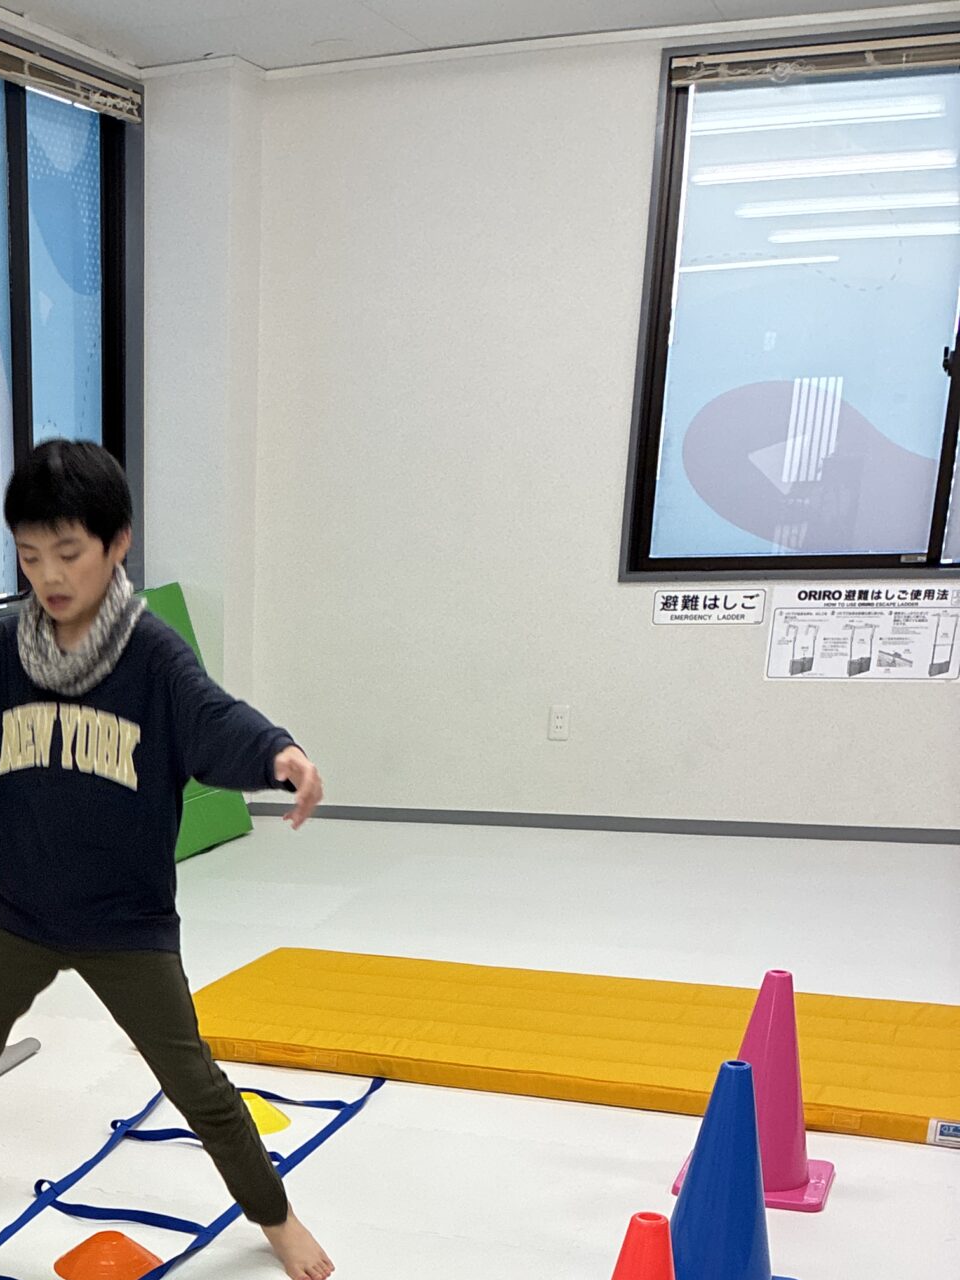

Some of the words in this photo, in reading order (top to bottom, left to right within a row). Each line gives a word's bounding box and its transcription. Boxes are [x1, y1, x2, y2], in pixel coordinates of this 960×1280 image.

[660, 594, 760, 611] 避難はしご
[797, 590, 842, 601] ORIRO
[844, 589, 949, 601] 避難はしご使用法
[59, 702, 140, 792] YORK
